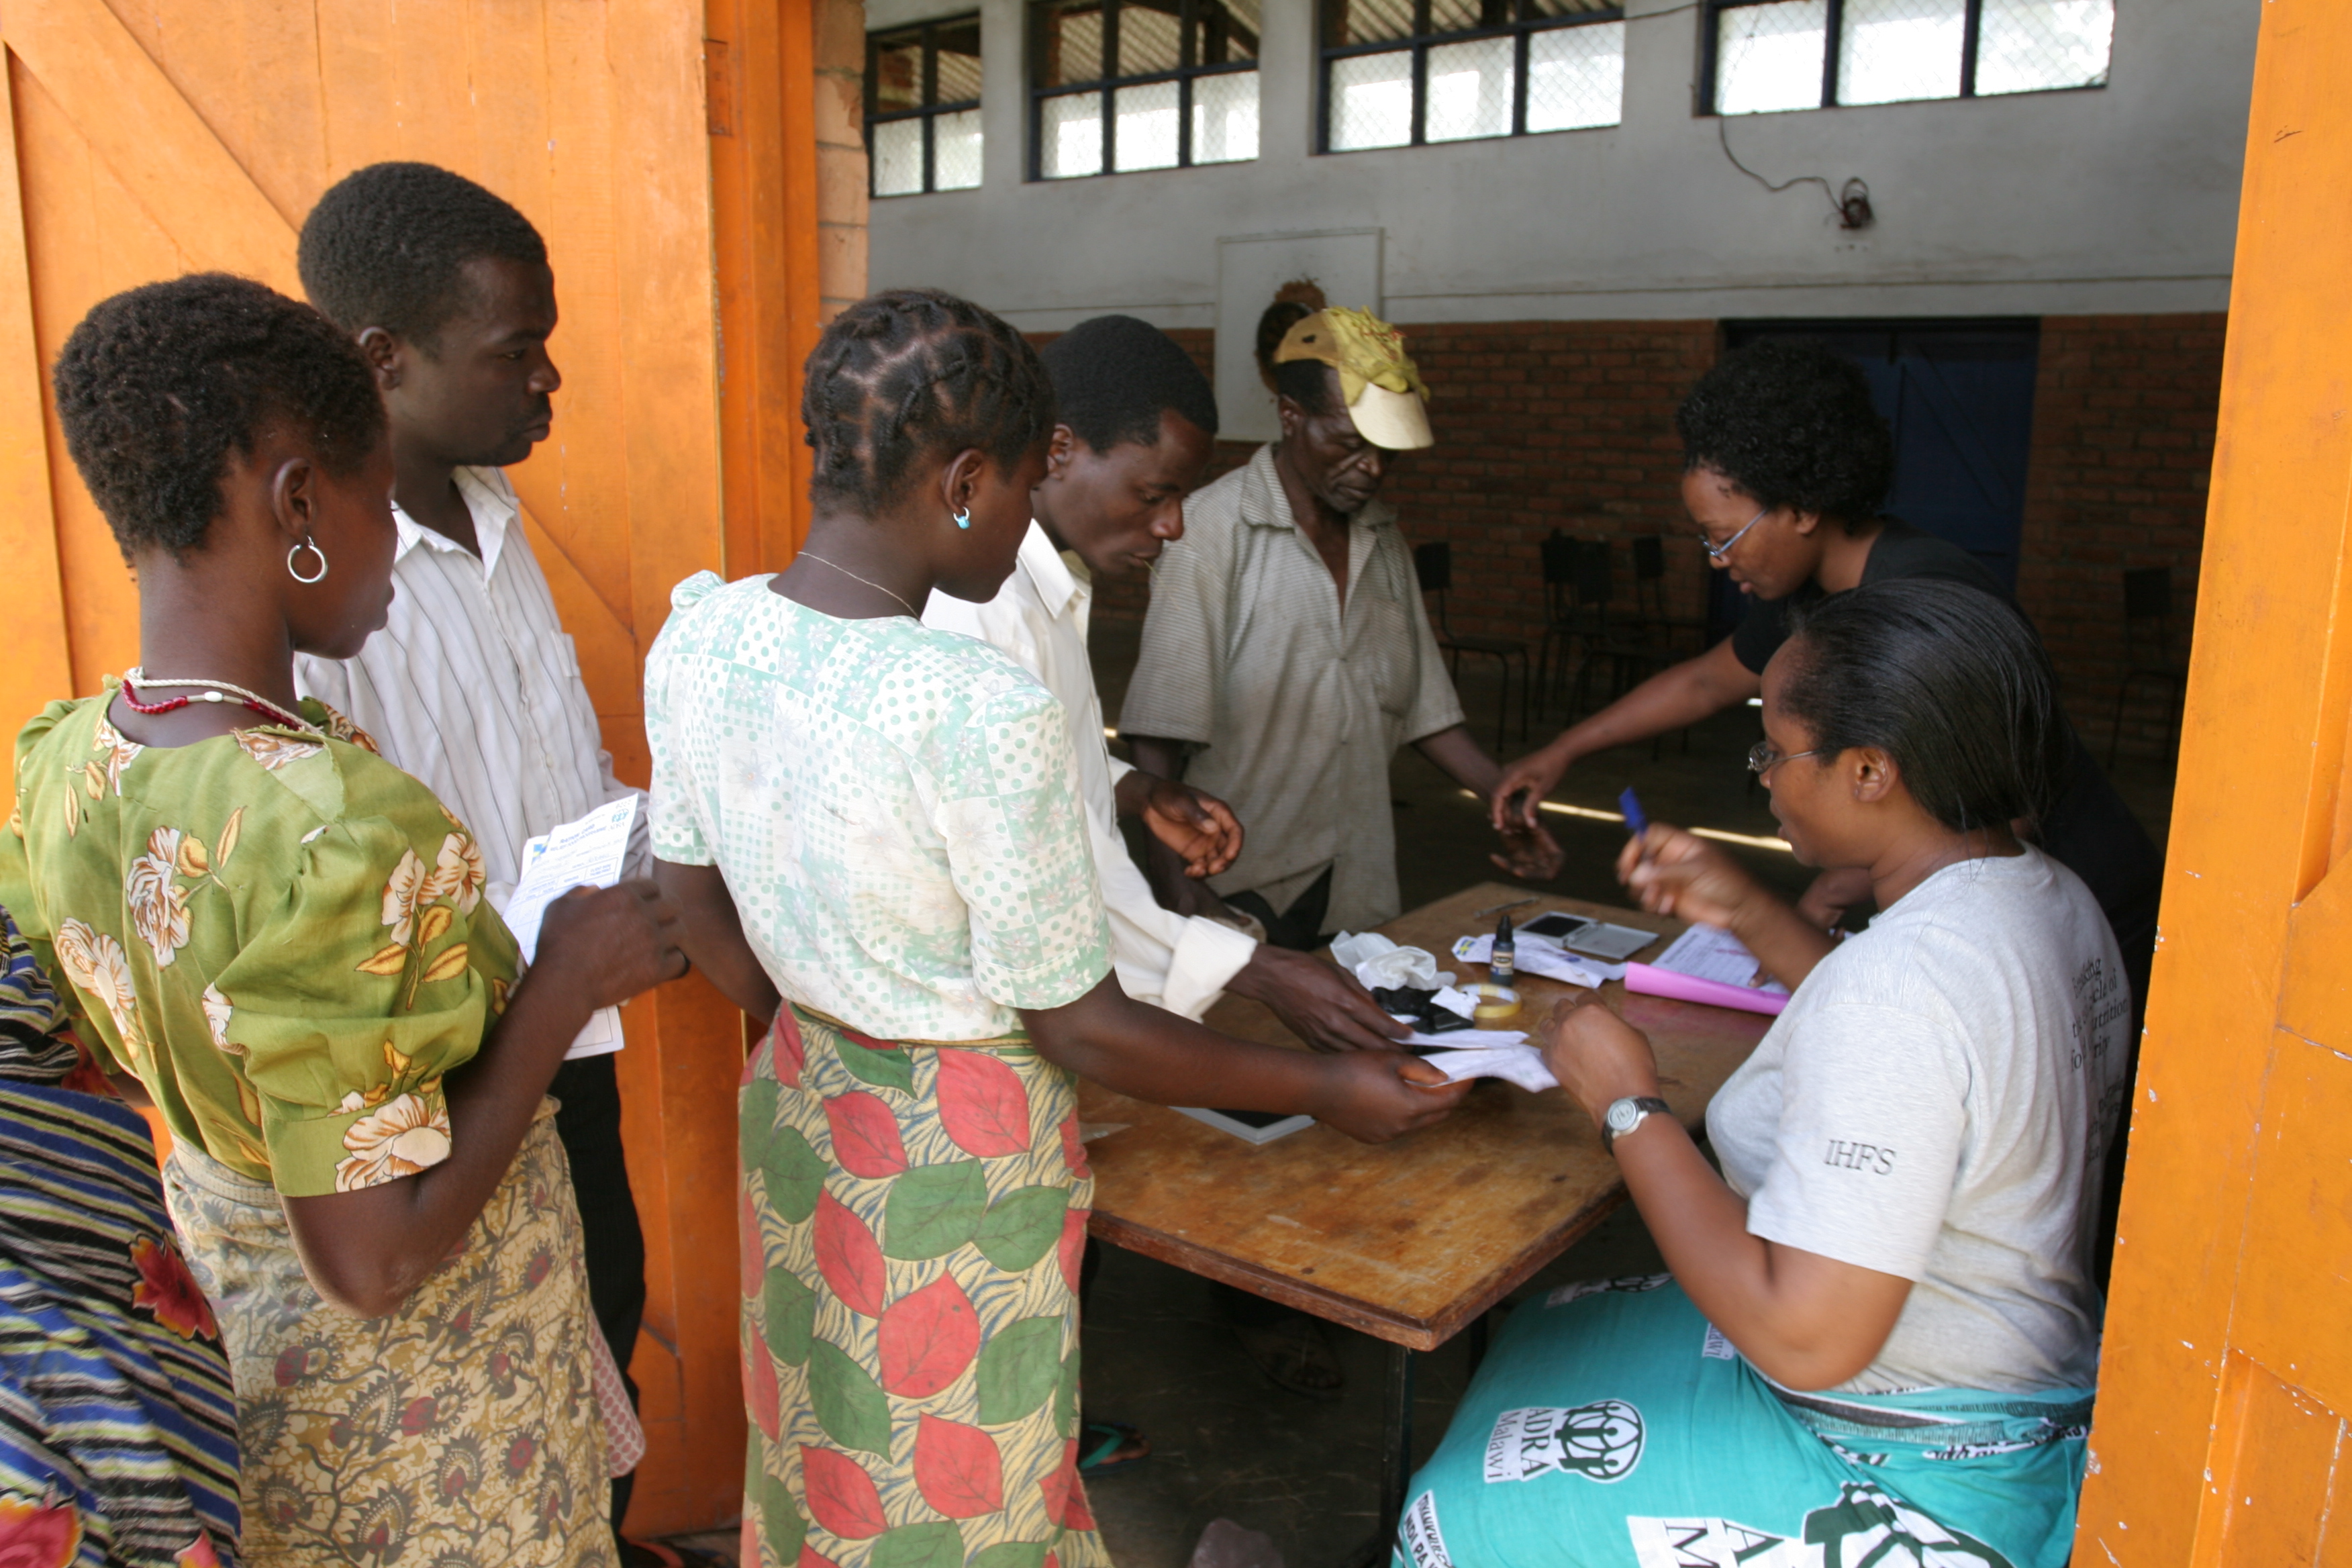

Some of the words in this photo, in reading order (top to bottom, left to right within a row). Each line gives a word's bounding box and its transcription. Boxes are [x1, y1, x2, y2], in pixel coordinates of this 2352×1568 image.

[2109, 967, 2118, 992] of
[1824, 1139, 1897, 1175] IHFS
[1487, 1411, 1522, 1479] Malawi
[1521, 1408, 1556, 1477] ADRA
[1413, 1542, 1428, 1566] PA
